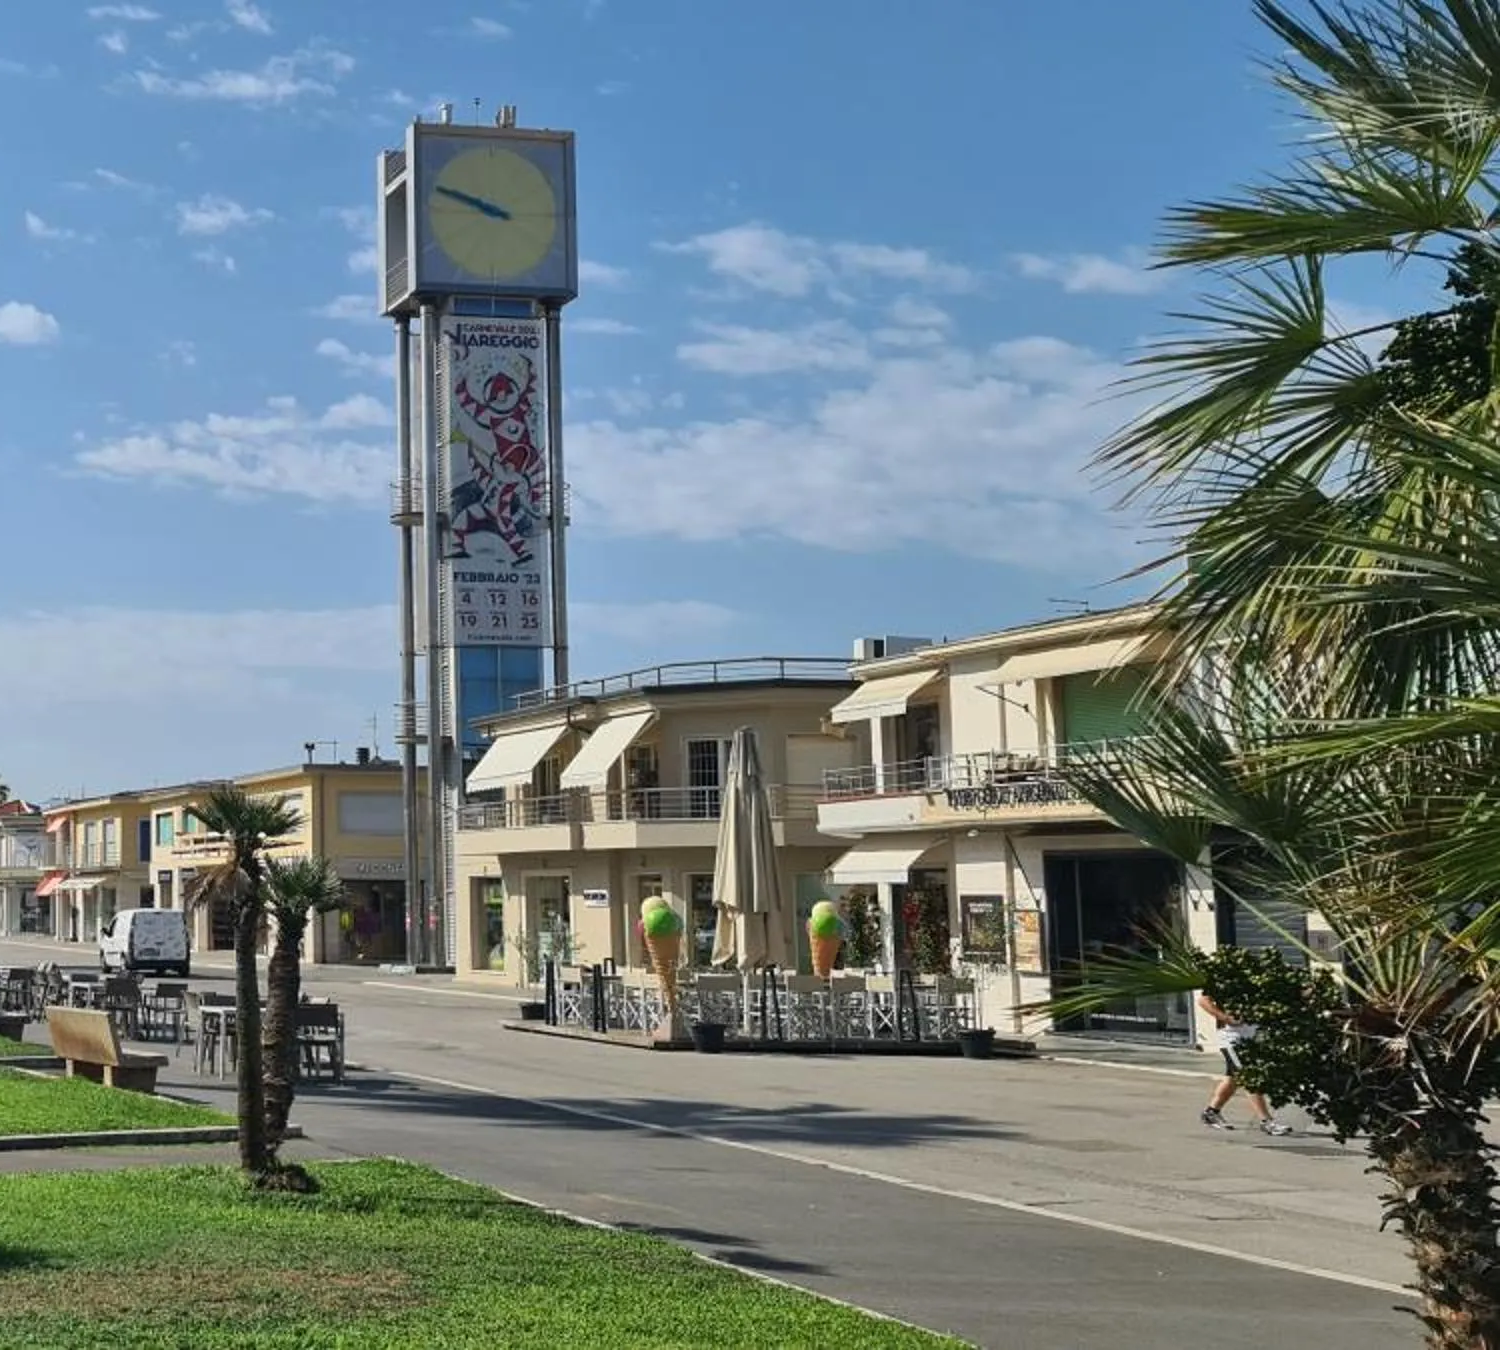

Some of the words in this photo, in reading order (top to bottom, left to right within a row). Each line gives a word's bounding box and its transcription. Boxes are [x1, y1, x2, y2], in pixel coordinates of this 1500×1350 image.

[463, 323, 516, 334] CARNEVALE
[443, 324, 540, 358] VIAREGGIO
[453, 571, 519, 583] FEBBRAIO
[462, 593, 471, 604] 4
[489, 593, 506, 605] 12
[521, 593, 538, 605] 16
[461, 615, 477, 627] 19
[492, 615, 507, 627] 21
[521, 616, 539, 628] 25
